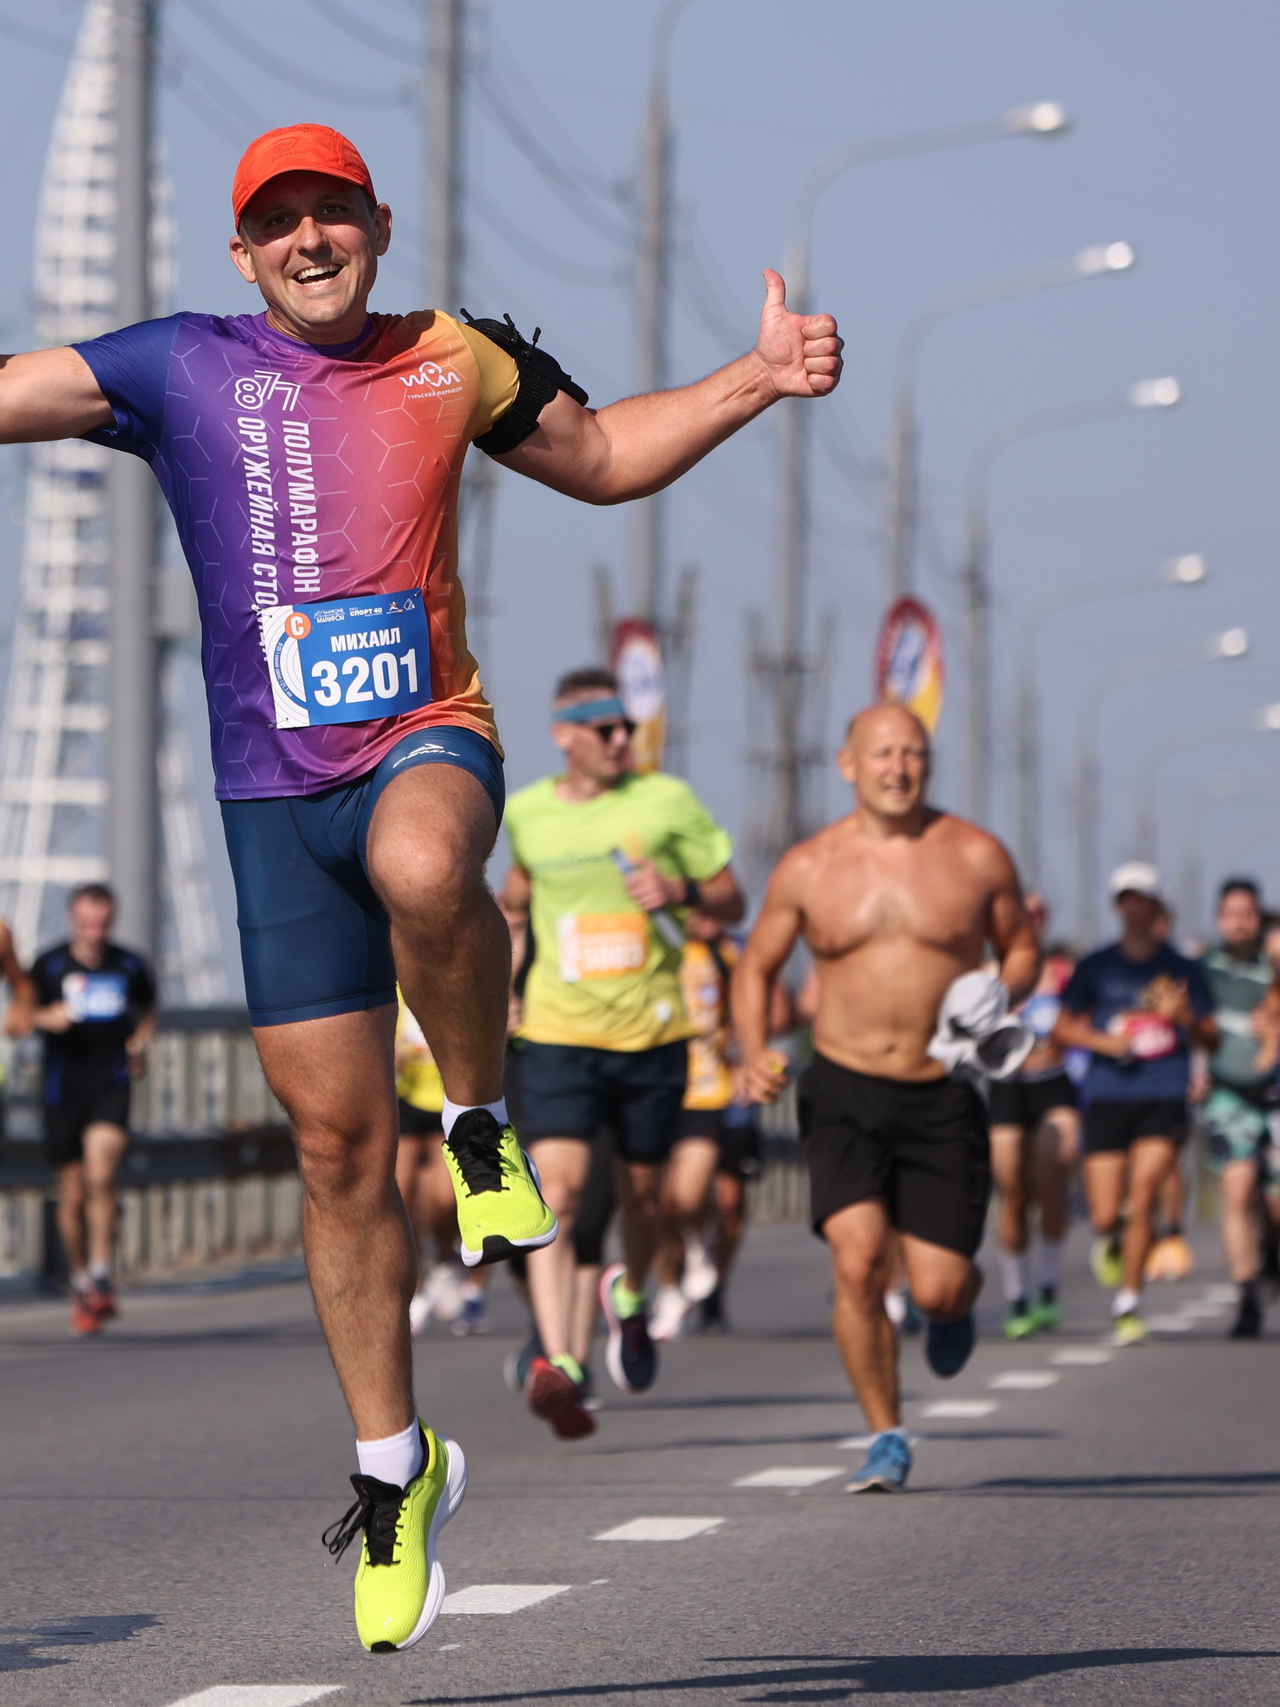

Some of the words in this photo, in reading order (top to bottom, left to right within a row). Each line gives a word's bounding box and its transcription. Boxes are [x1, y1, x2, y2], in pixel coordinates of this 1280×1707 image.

[407, 391, 437, 400] ТУЛЬСКИЙ
[437, 386, 463, 397] МАРАФОН
[237, 417, 279, 556] ОРУЖЕЙНАЯ
[282, 420, 321, 593] ПОЛУМАРАФОН
[349, 608, 373, 617] СПОРТ
[330, 627, 401, 653] МИХАИЛ
[311, 648, 418, 707] 3201
